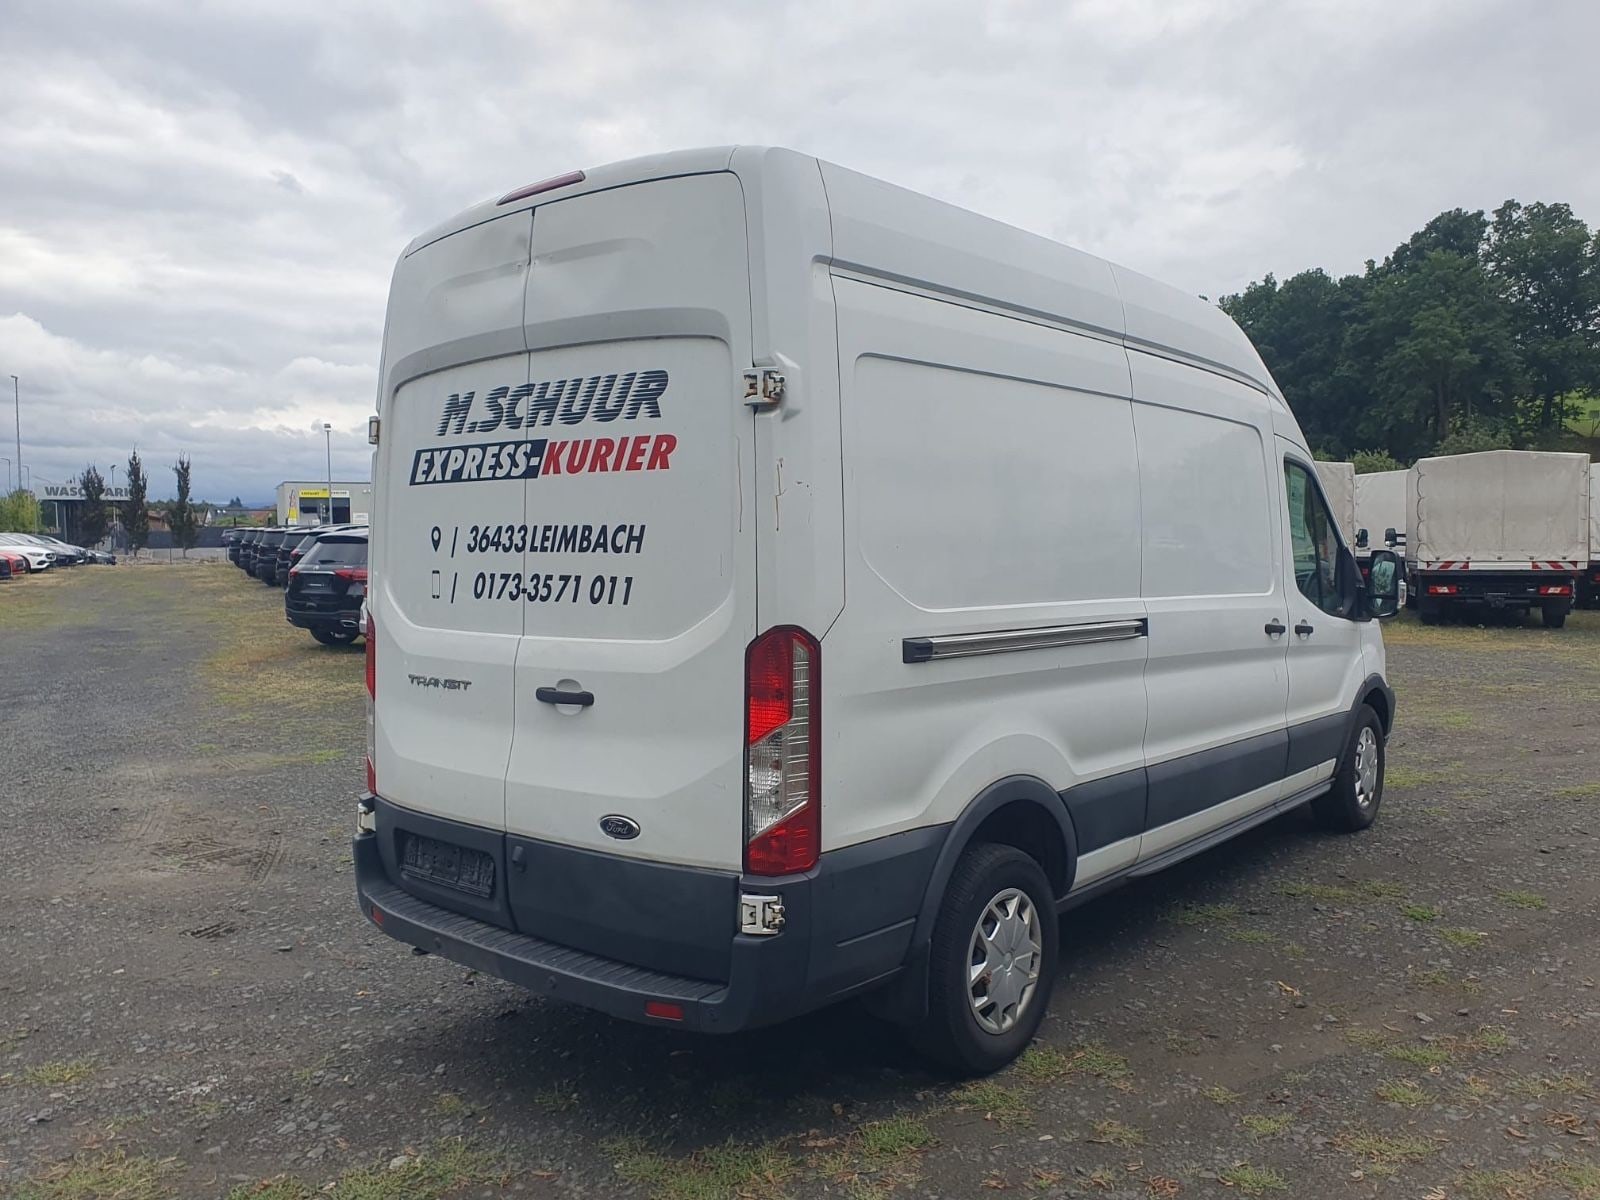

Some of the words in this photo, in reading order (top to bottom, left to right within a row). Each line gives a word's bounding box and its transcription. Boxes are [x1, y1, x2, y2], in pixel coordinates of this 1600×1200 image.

[436, 370, 669, 436] M.SCHUUR
[467, 525, 528, 553] 36433
[529, 524, 646, 554] LEIMBACH
[589, 575, 633, 605] 011
[408, 674, 472, 691] TRANSIT
